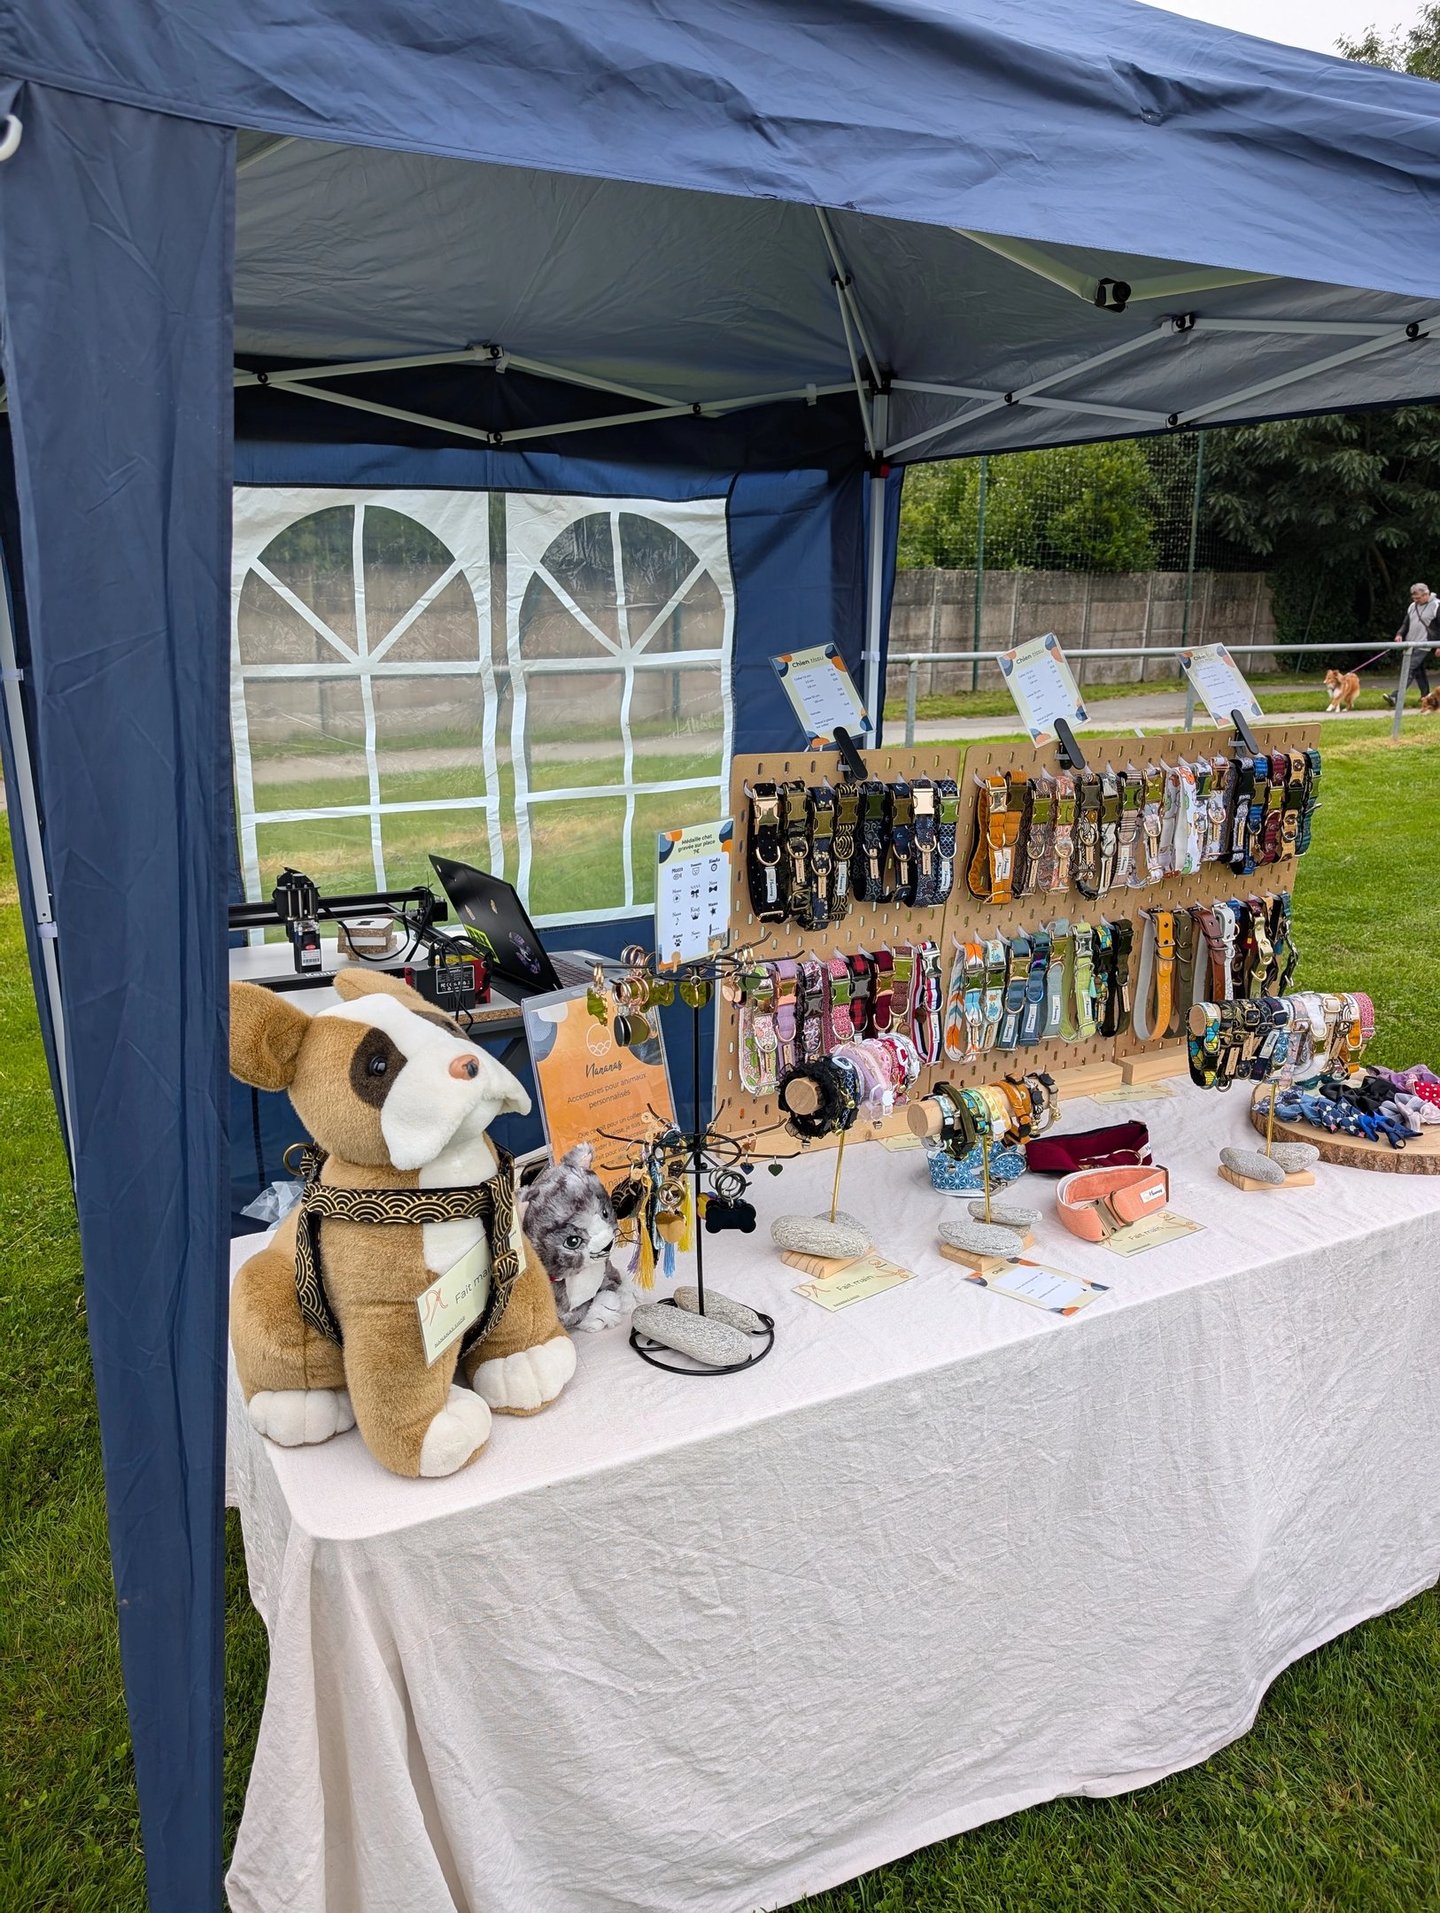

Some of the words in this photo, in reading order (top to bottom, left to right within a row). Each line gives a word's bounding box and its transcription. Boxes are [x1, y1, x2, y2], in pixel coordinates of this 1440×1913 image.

[792, 659, 810, 668] Chien
[810, 656, 824, 664] tissu
[1016, 654, 1032, 664] Chien
[682, 836, 701, 844] Médaille
[703, 839, 716, 847] place
[567, 1087, 604, 1104] Accessoires
[605, 1082, 619, 1092] pour
[620, 1073, 647, 1086] animaux
[588, 1089, 631, 1110] personnalisés
[607, 1120, 619, 1128] pour
[1128, 1232, 1144, 1240] Fait
[1145, 1225, 1165, 1237] main
[454, 1284, 473, 1304] Fait
[473, 1266, 492, 1287] mai
[836, 1282, 852, 1292] Fait
[854, 1275, 875, 1286] main
